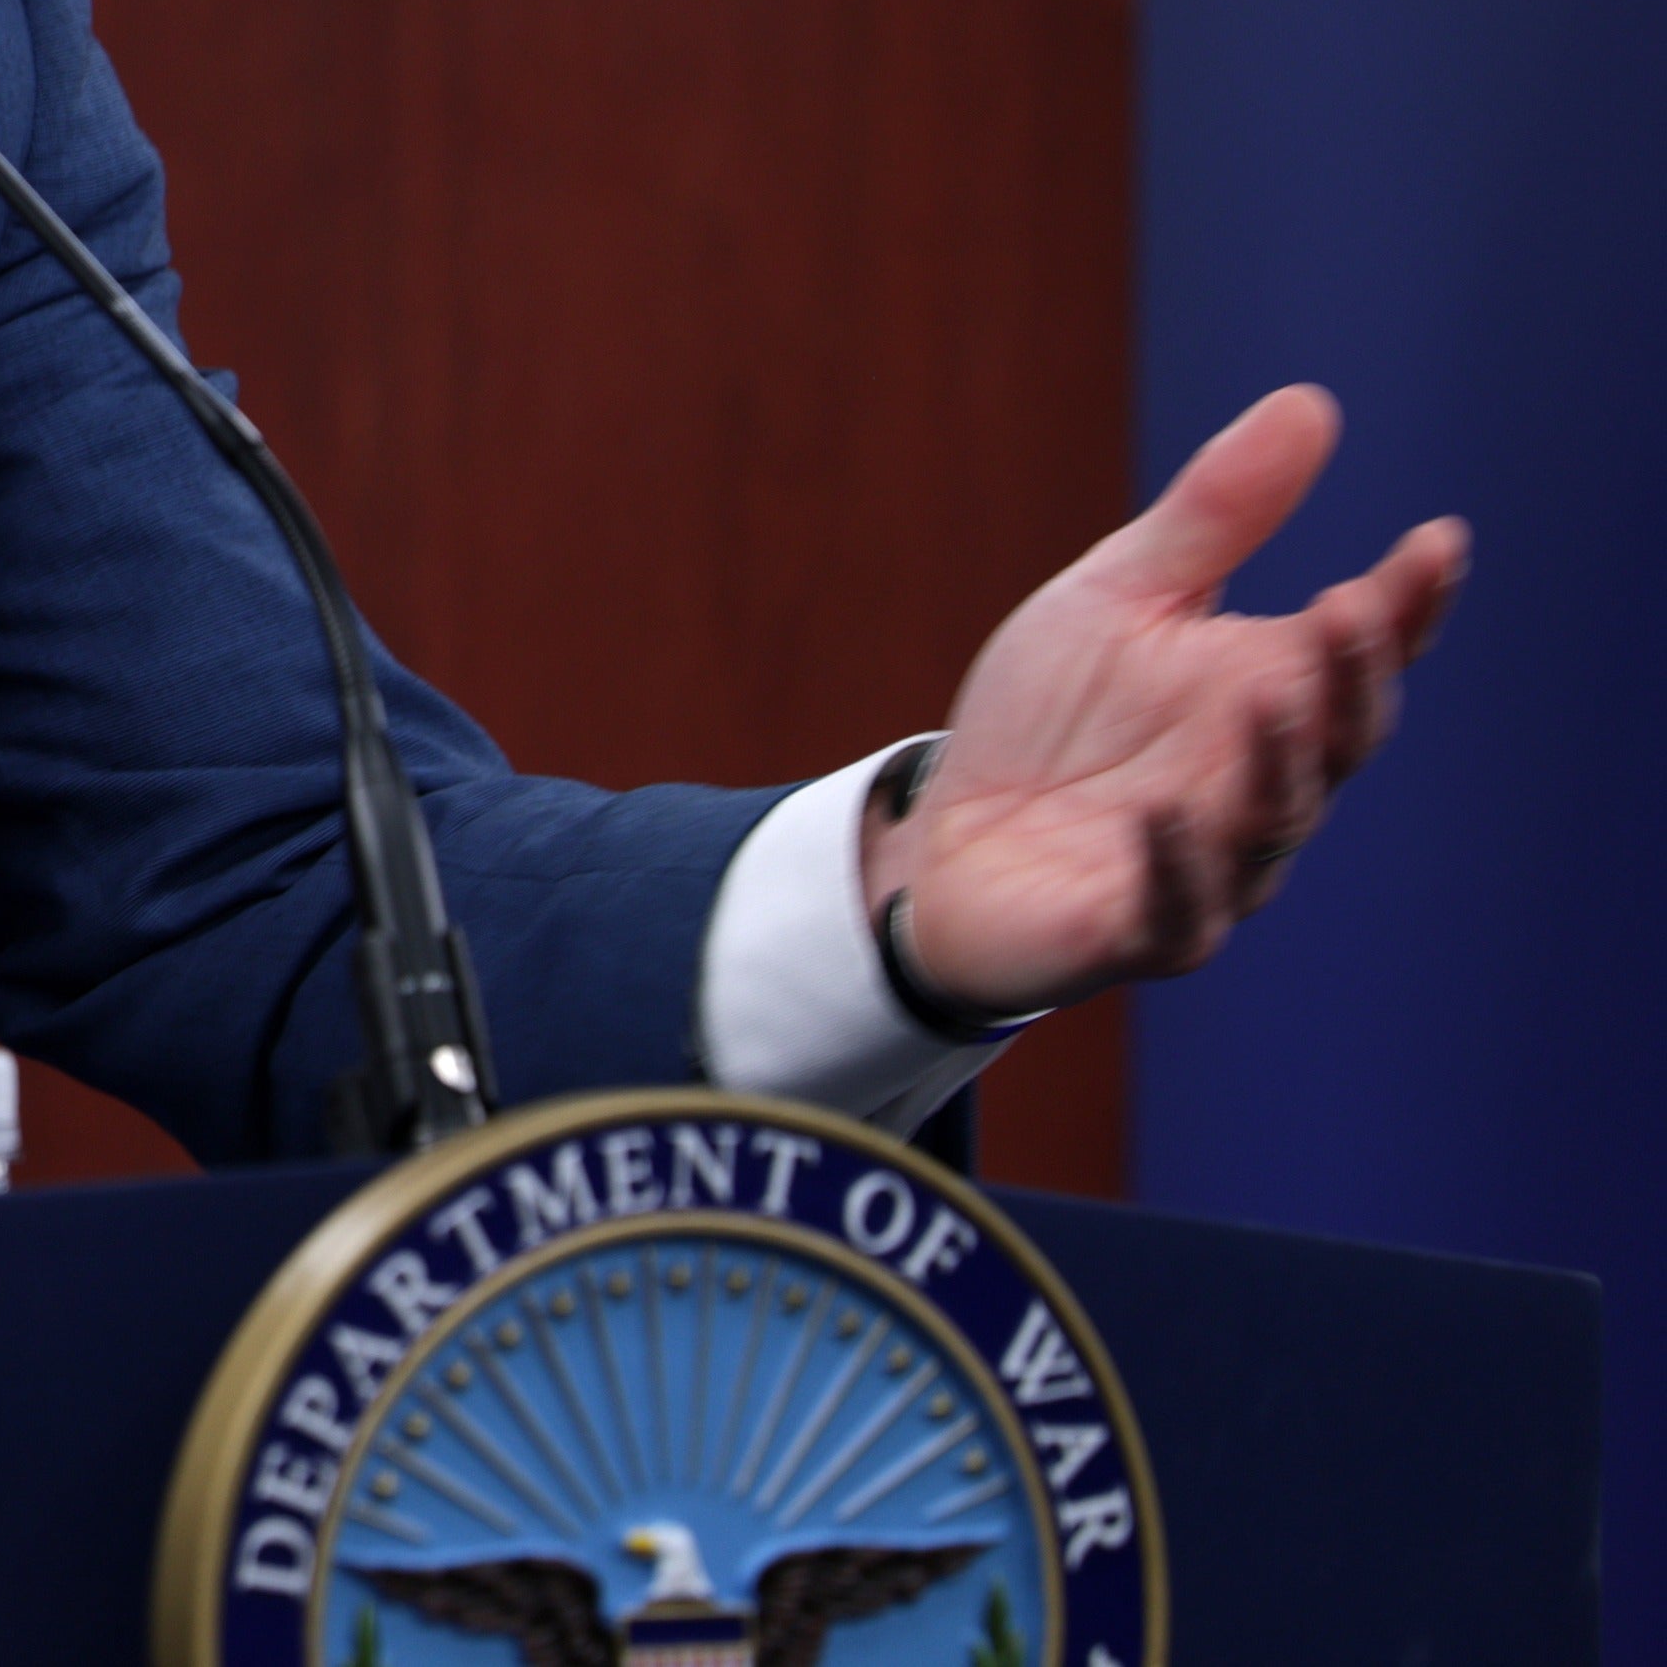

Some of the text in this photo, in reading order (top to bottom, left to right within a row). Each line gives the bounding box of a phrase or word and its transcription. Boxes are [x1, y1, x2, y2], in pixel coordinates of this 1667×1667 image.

[238, 1125, 1133, 1595] DEPARTMENT OF WAR
